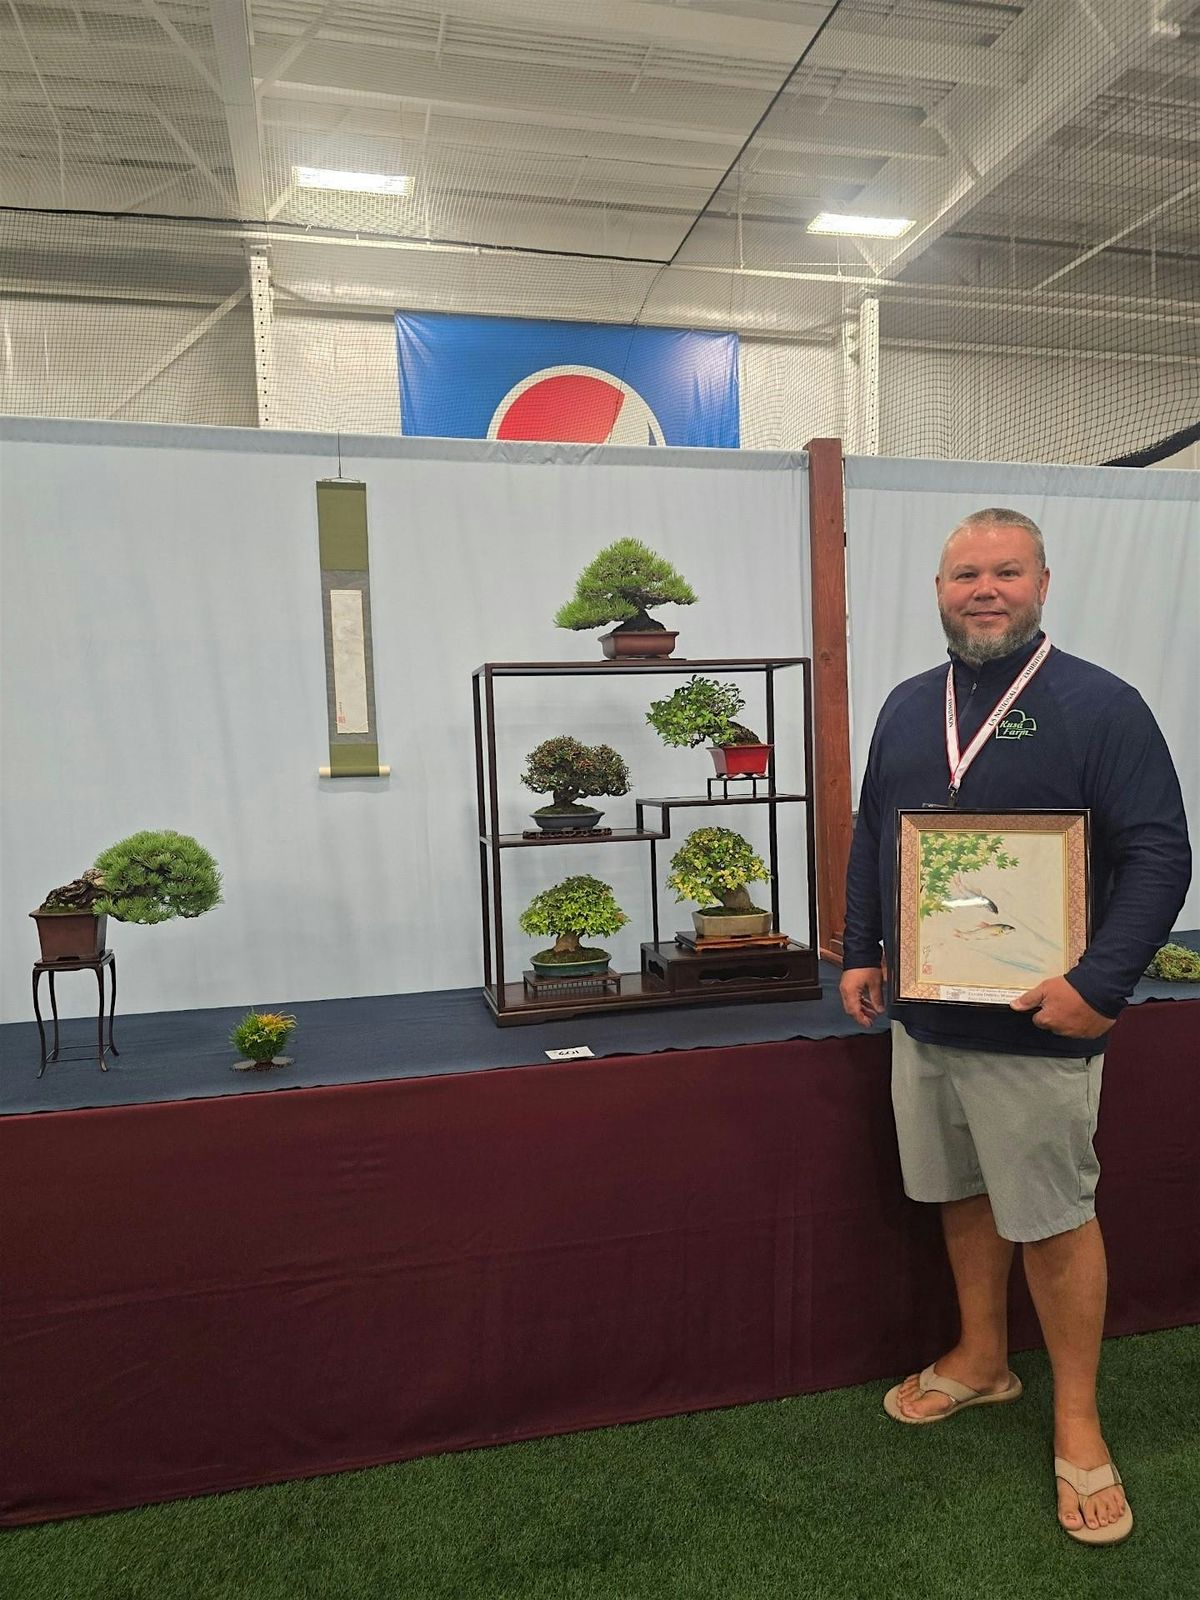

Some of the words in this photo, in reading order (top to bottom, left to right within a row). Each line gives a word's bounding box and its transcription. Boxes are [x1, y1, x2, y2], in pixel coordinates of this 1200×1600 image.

[994, 689, 1017, 718] NATIONAL
[1023, 648, 1047, 679] EXHIBITION
[1003, 728, 1033, 737] Farm
